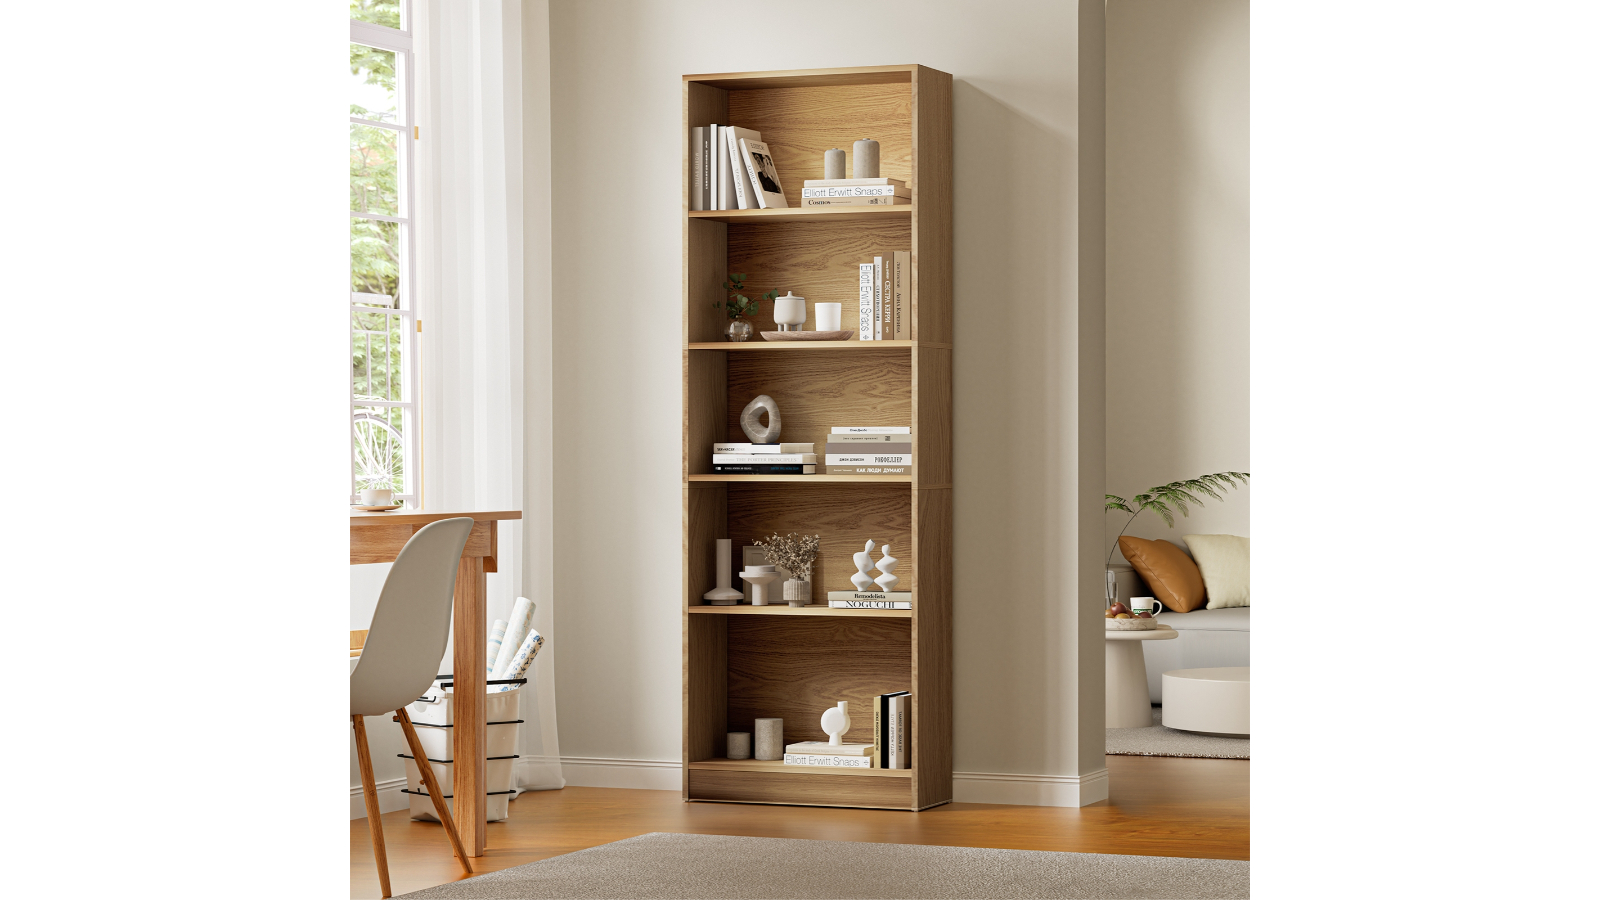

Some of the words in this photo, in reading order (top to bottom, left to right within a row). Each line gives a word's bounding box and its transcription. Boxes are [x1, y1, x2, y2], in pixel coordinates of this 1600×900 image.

[804, 188, 826, 198] Elliott
[828, 187, 852, 197] Erwitt
[854, 186, 883, 197] Snaps
[860, 265, 872, 285] Elliott
[860, 286, 872, 307] Erwitt
[845, 600, 895, 608] NOGUCHI
[785, 754, 807, 765] Elliott
[808, 755, 831, 766] Erwitt
